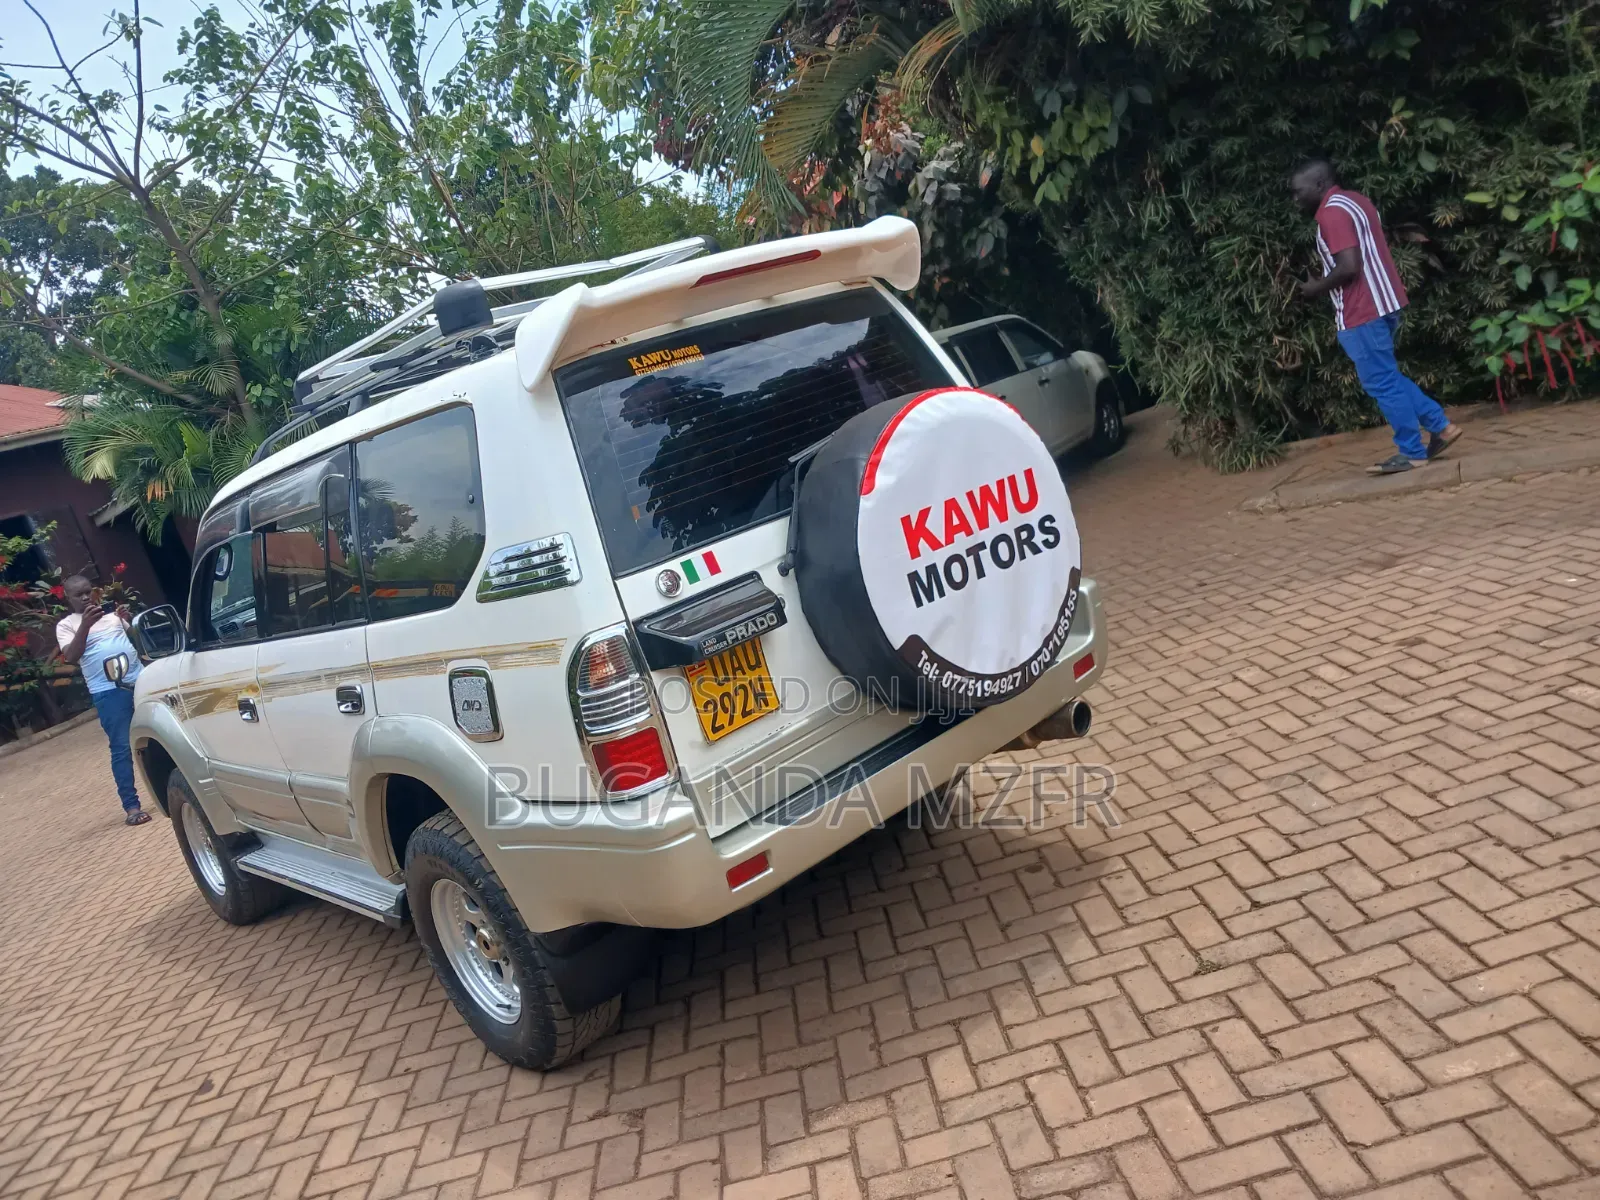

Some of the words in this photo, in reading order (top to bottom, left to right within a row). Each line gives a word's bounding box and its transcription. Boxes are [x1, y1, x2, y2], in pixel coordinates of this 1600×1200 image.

[628, 349, 673, 369] KAWU
[671, 345, 701, 359] MOTORS
[900, 467, 1039, 560] KAWU
[907, 514, 1061, 608] MOTORS
[701, 637, 717, 648] LAND
[725, 612, 778, 644] PRADO
[917, 650, 939, 681] Tel:
[942, 667, 1022, 697] 0775194927
[1031, 588, 1077, 676] 0701195153
[704, 641, 728, 655] CRUISER
